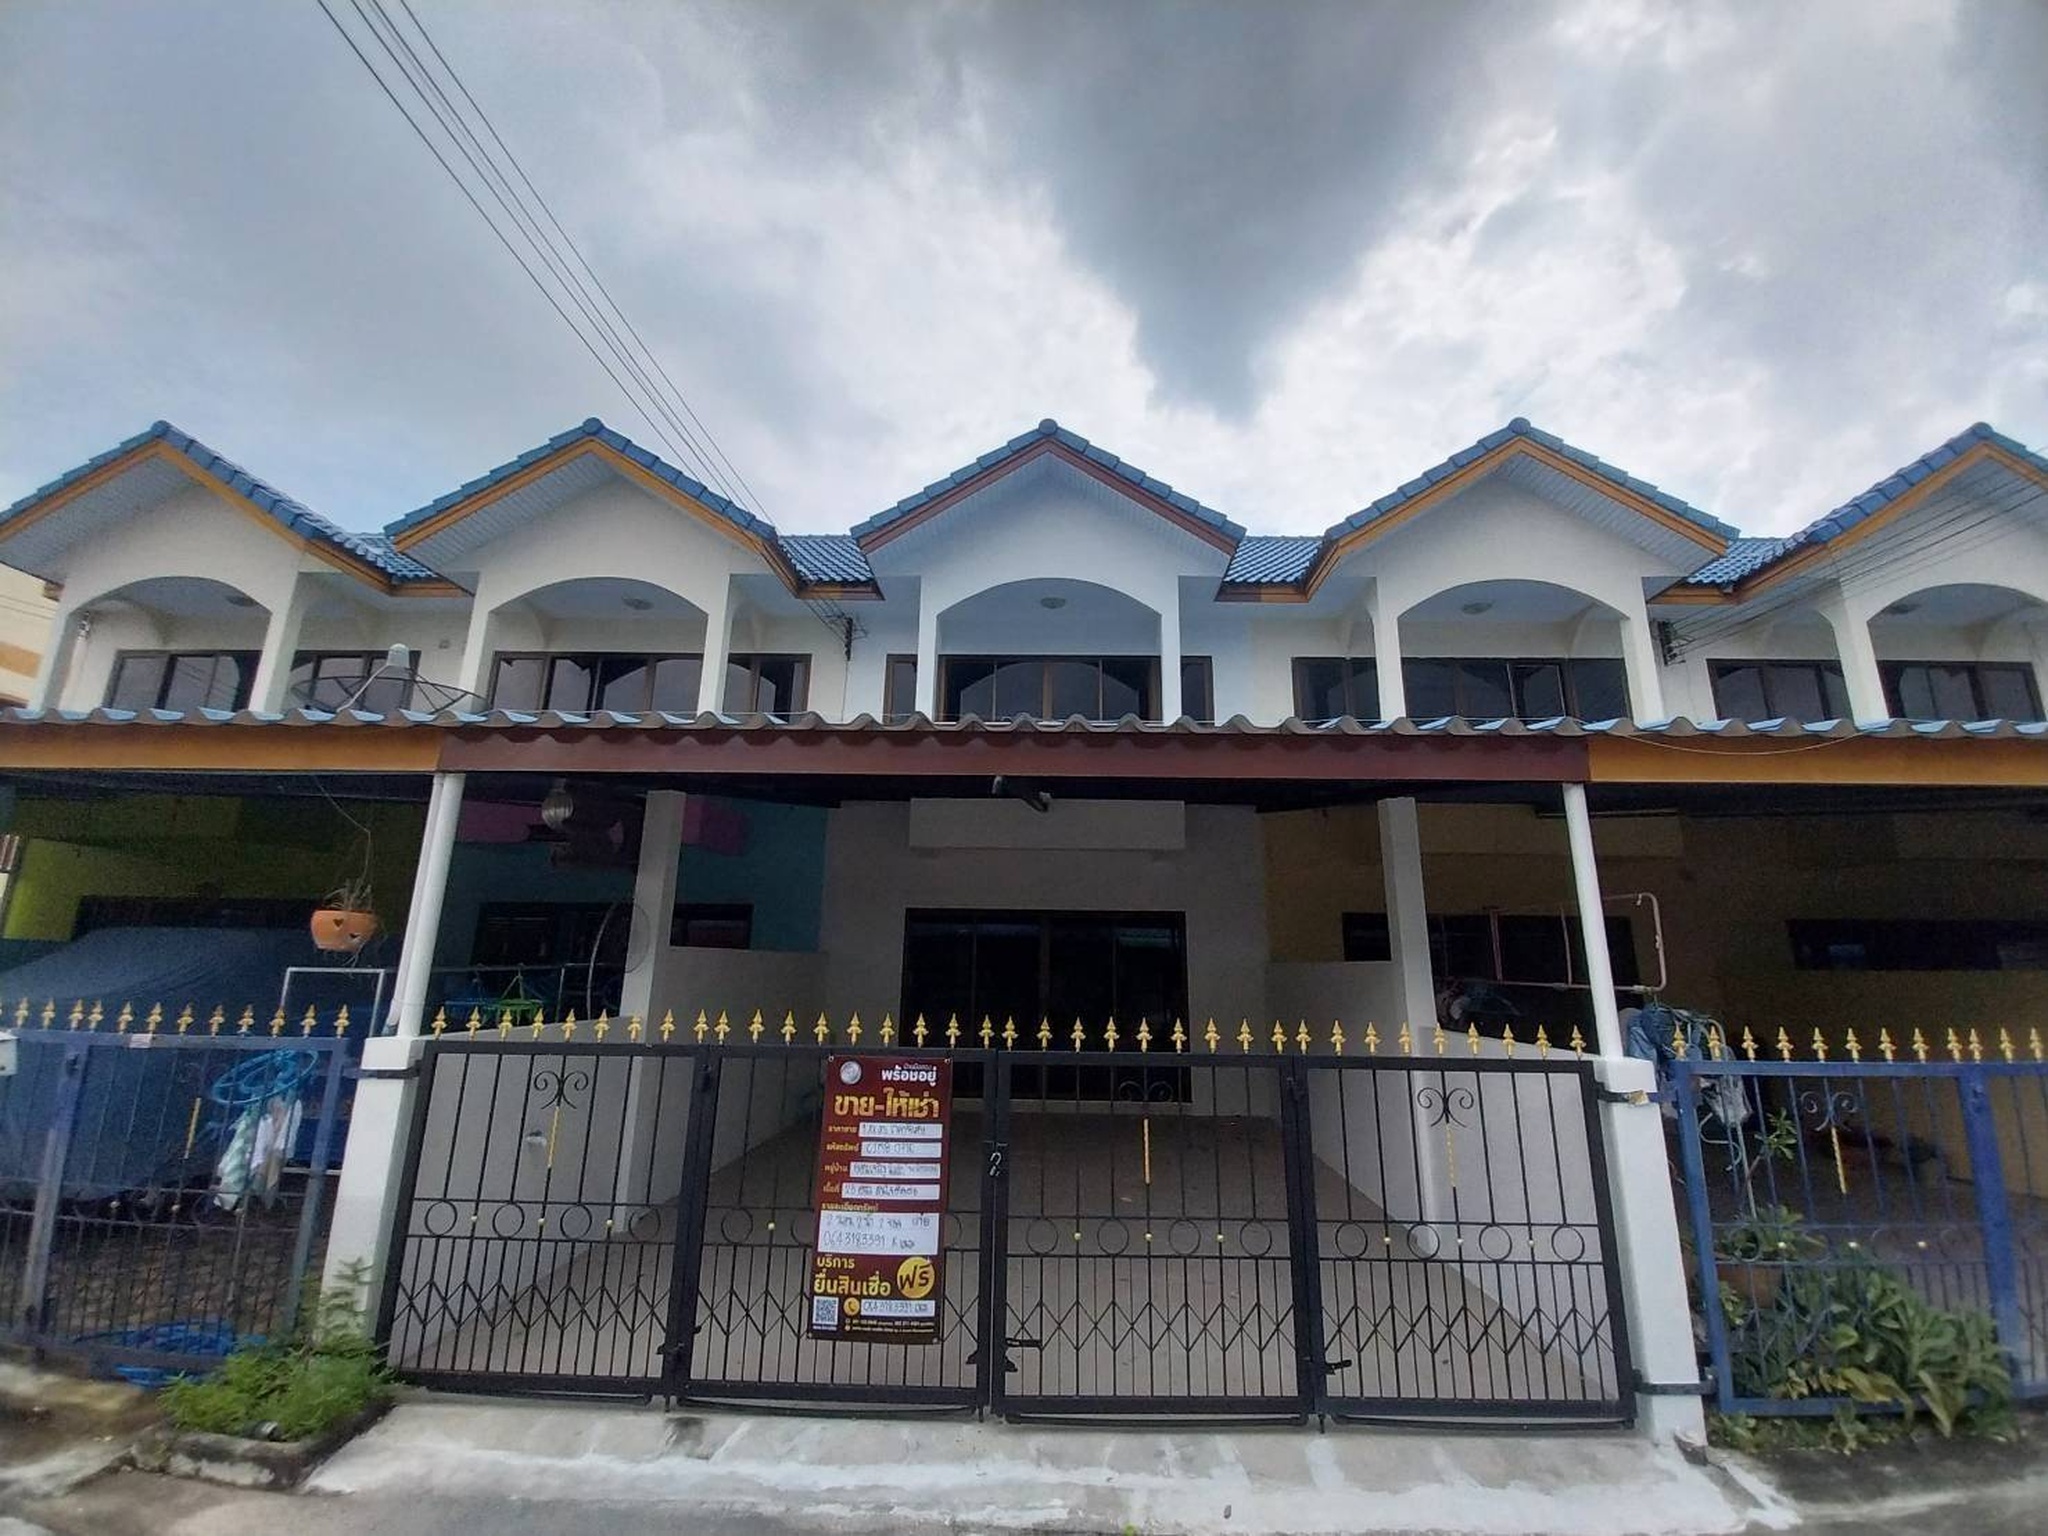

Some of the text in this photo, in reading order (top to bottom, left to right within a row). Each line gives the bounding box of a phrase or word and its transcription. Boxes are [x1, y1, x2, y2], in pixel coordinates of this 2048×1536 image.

[881, 1065, 937, 1086] พร้อมอยู่
[835, 1087, 938, 1117] ขาย-ให้เช่า
[817, 1254, 855, 1269] บริการ
[814, 1268, 891, 1297] ยื่นสินเชื่อ
[899, 1263, 931, 1290] ฟรี
